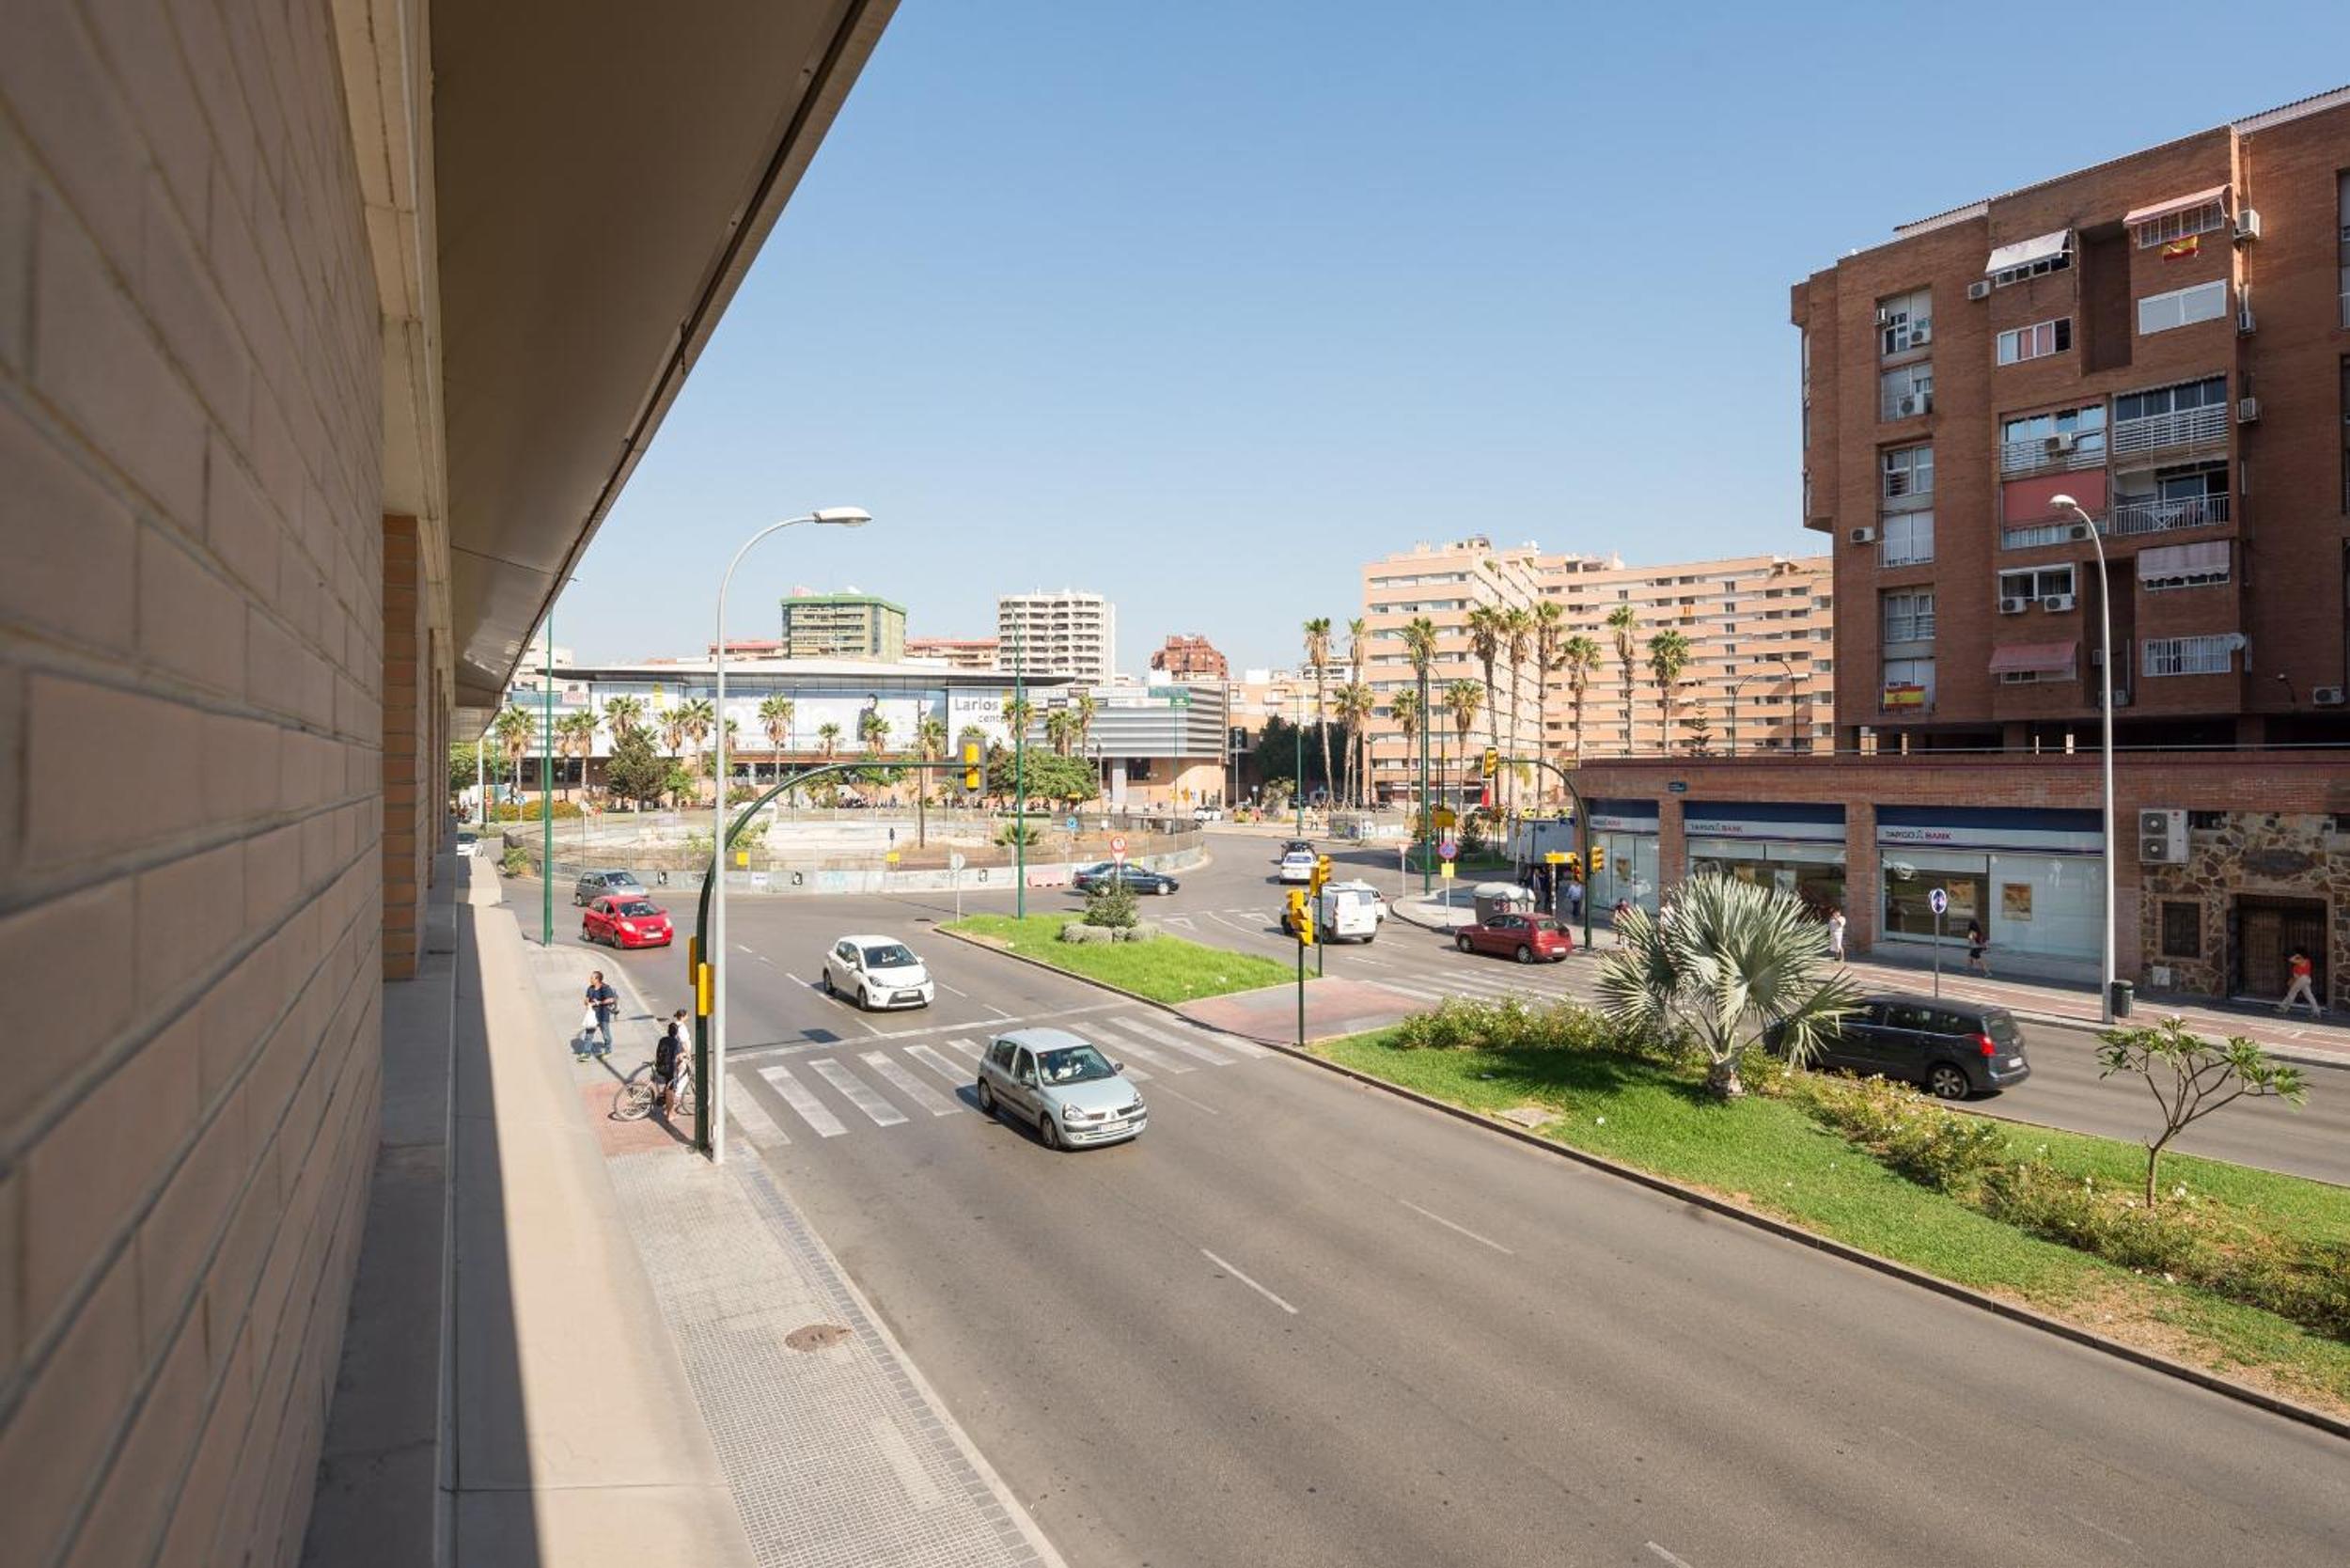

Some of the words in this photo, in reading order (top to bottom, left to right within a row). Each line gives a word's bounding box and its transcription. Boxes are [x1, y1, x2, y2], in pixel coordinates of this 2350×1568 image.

[955, 697, 999, 711] Larios
[1885, 830, 1916, 839] TARGO
[1924, 831, 1952, 839] BANK
